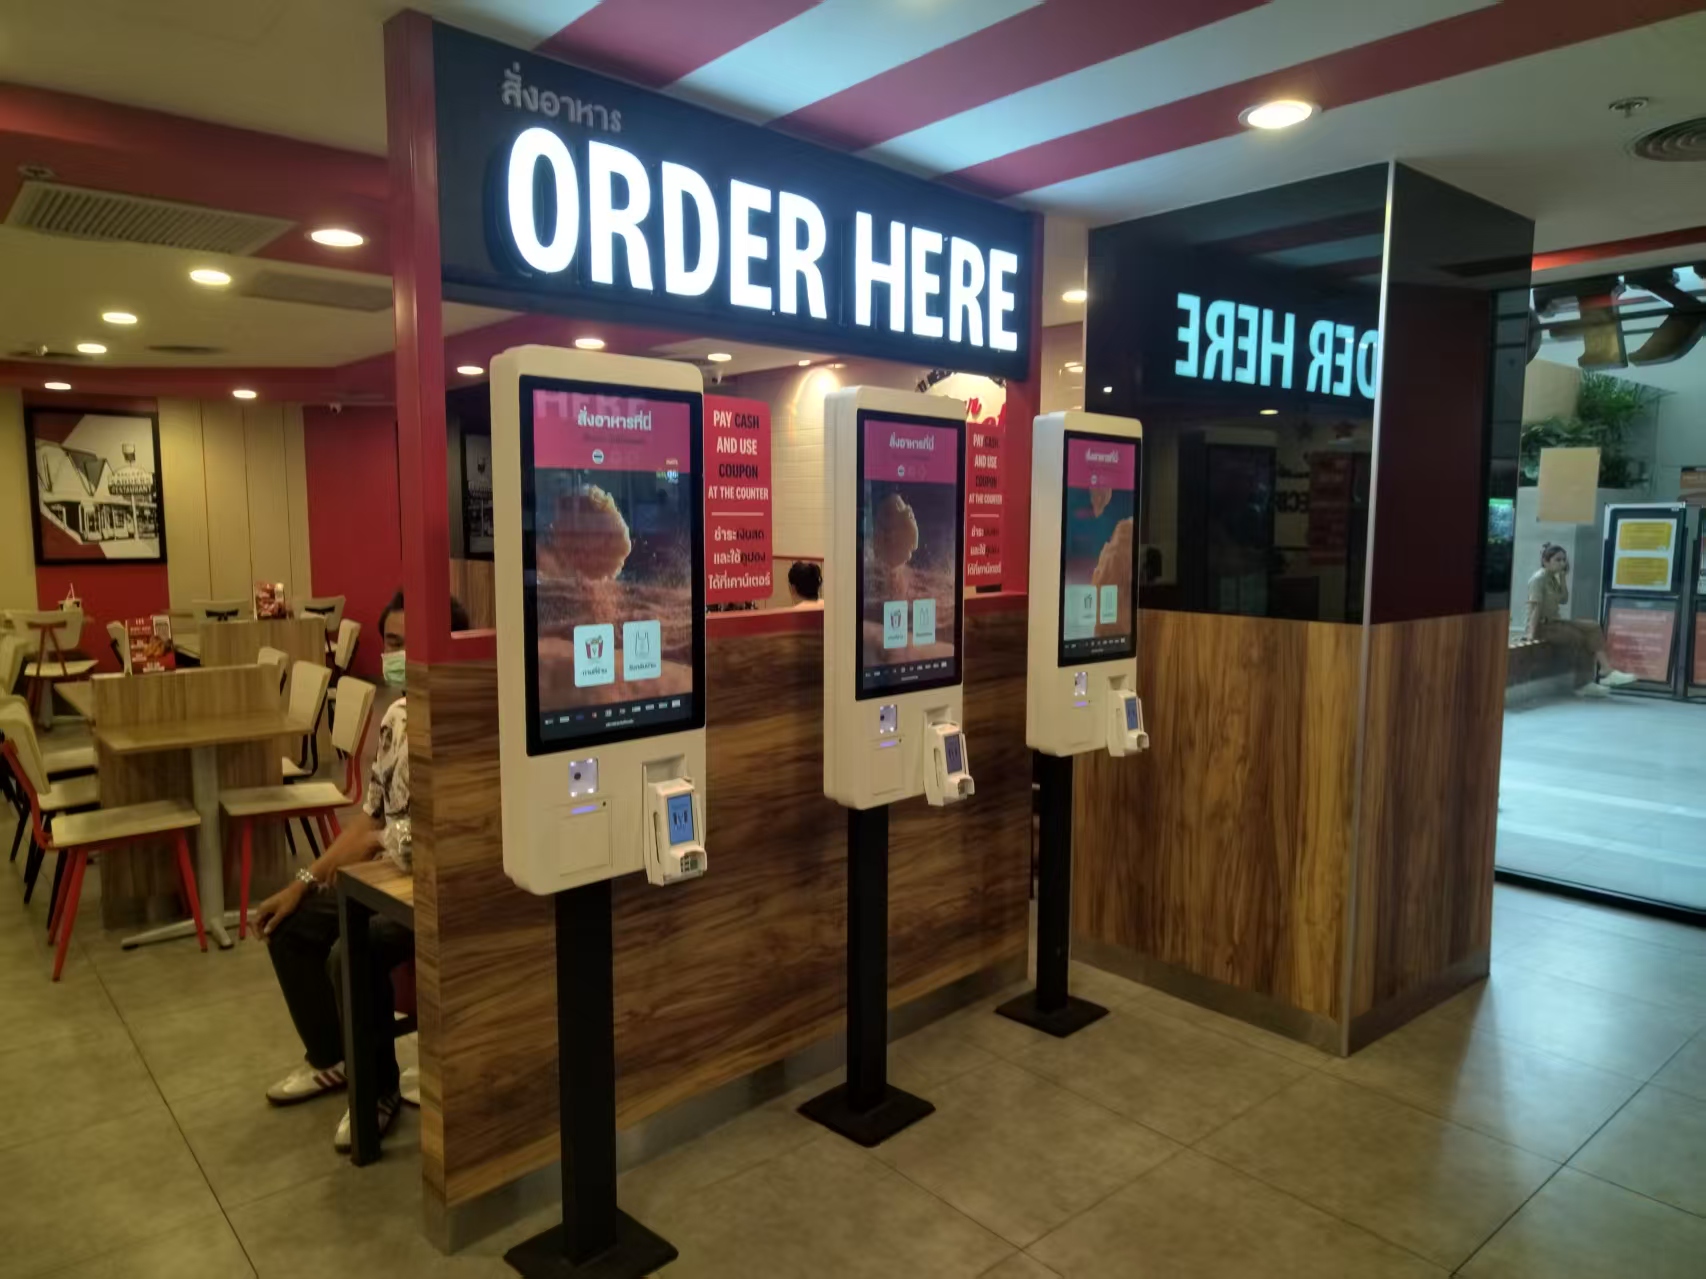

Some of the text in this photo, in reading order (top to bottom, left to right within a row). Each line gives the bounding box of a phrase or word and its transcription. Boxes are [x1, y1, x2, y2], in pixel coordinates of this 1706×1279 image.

[501, 61, 622, 133] สั่งอาหาร
[507, 126, 1019, 352] ORDER HERE
[713, 409, 760, 429] PAY CASH
[716, 436, 758, 455] AND USE
[973, 433, 984, 447] PAY
[719, 463, 758, 478] COUPON
[974, 454, 998, 469] AND USE
[708, 485, 769, 500] AT THE COUNTER
[714, 525, 765, 541] ชำระเงินสด
[713, 547, 766, 567] และใช้คูปอง
[708, 569, 771, 590] ได้ที่เคาน์เตอร์
